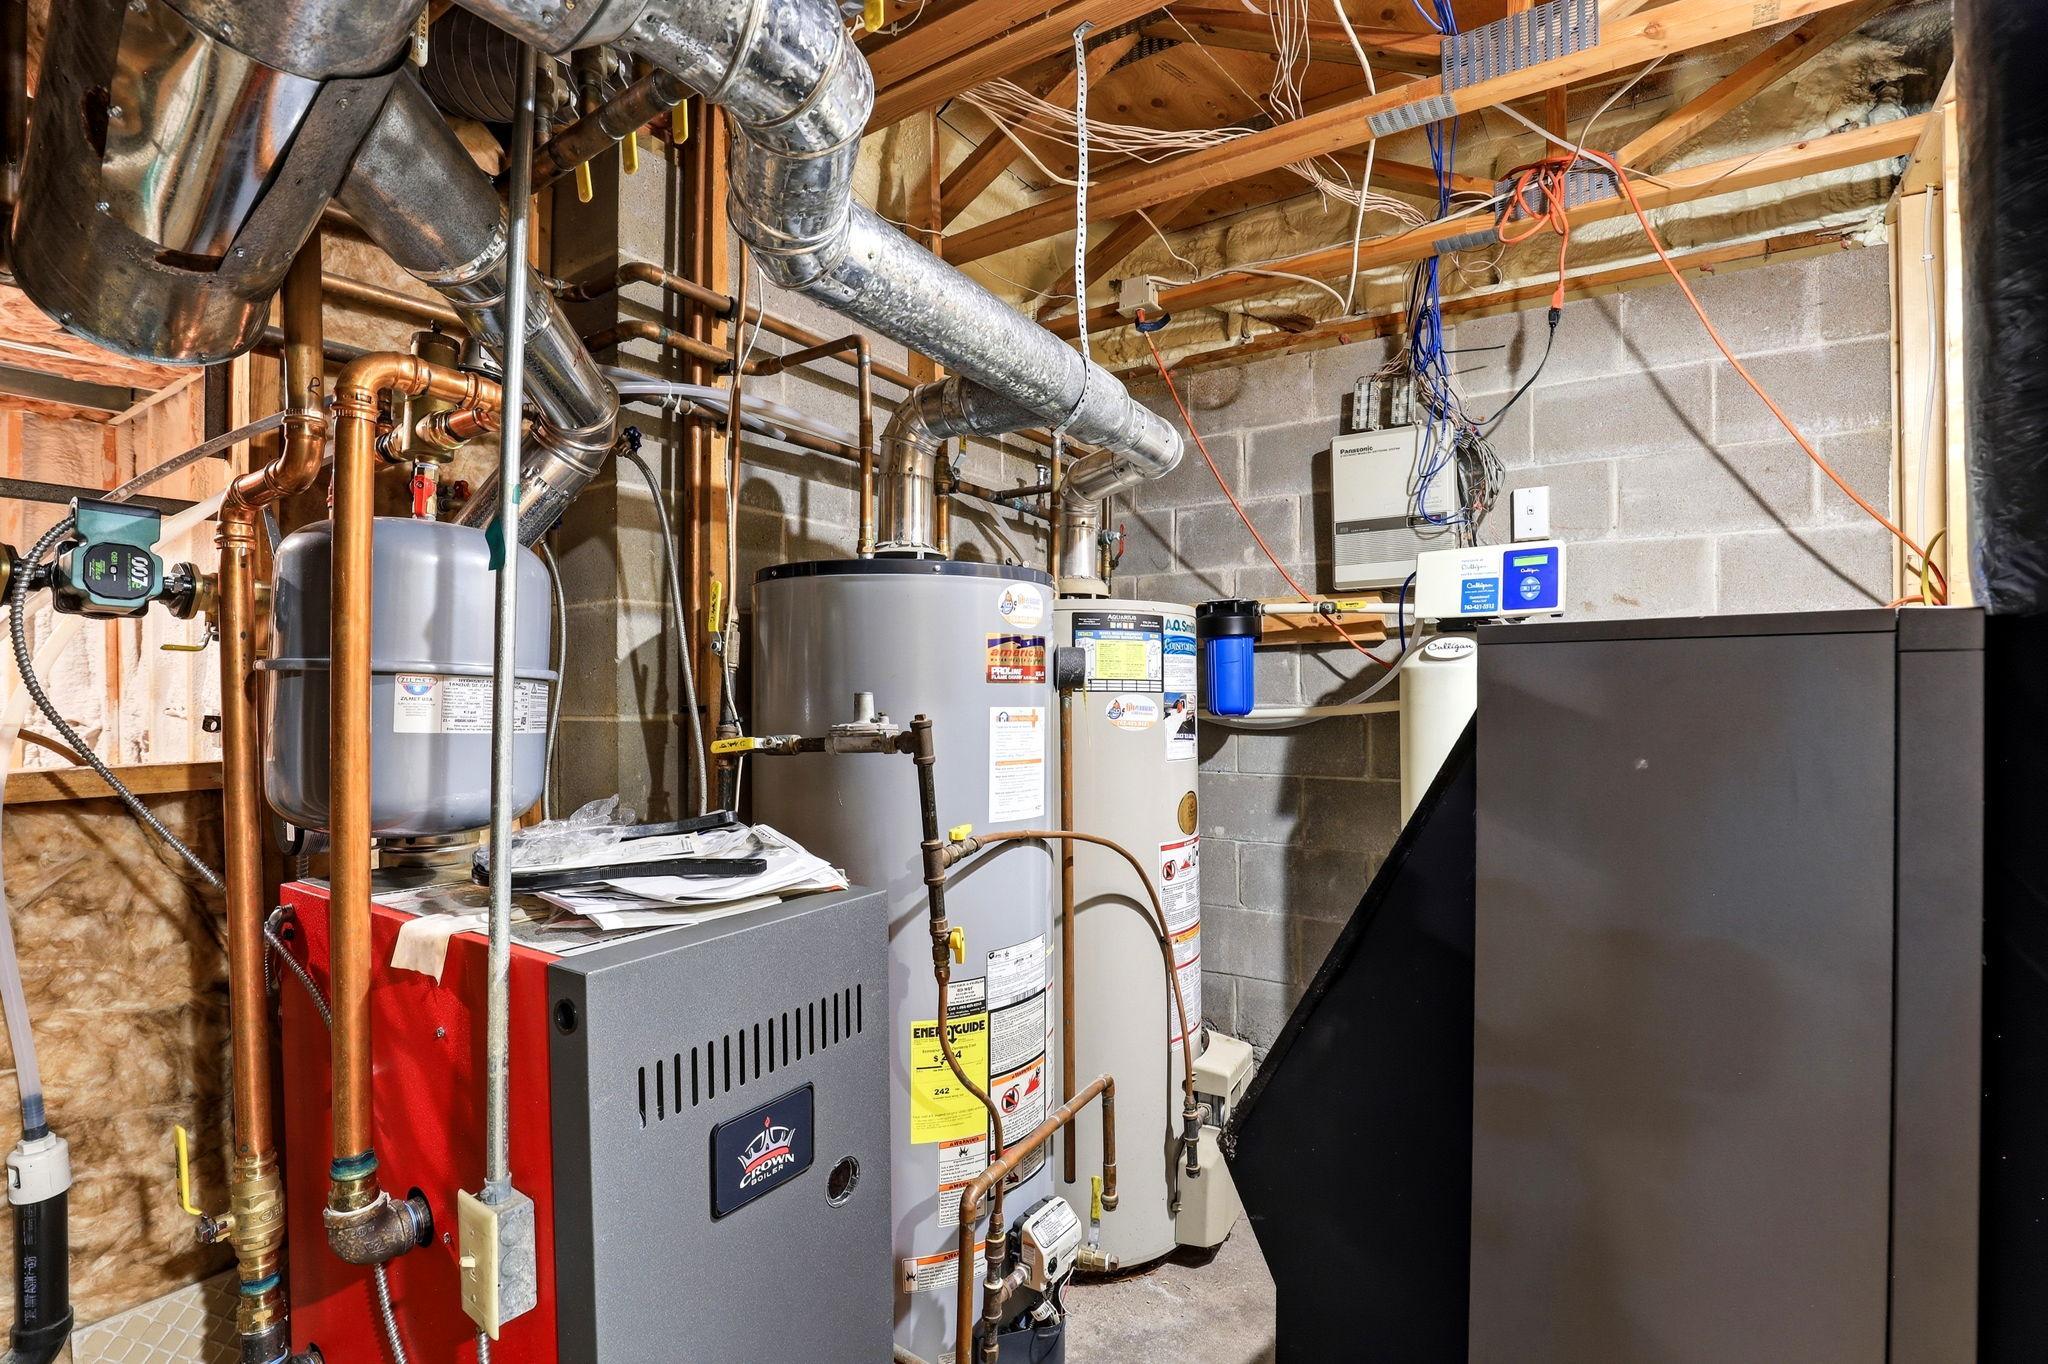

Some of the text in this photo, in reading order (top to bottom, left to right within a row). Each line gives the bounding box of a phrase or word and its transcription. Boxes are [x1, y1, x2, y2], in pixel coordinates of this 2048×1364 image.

[1340, 445, 1373, 455] Panasonic
[1466, 582, 1494, 590] Culligan
[1427, 641, 1474, 653] Culligan
[934, 1087, 950, 1096] 242
[739, 1153, 795, 1189] CROWN
[751, 1165, 784, 1186] BOILER
